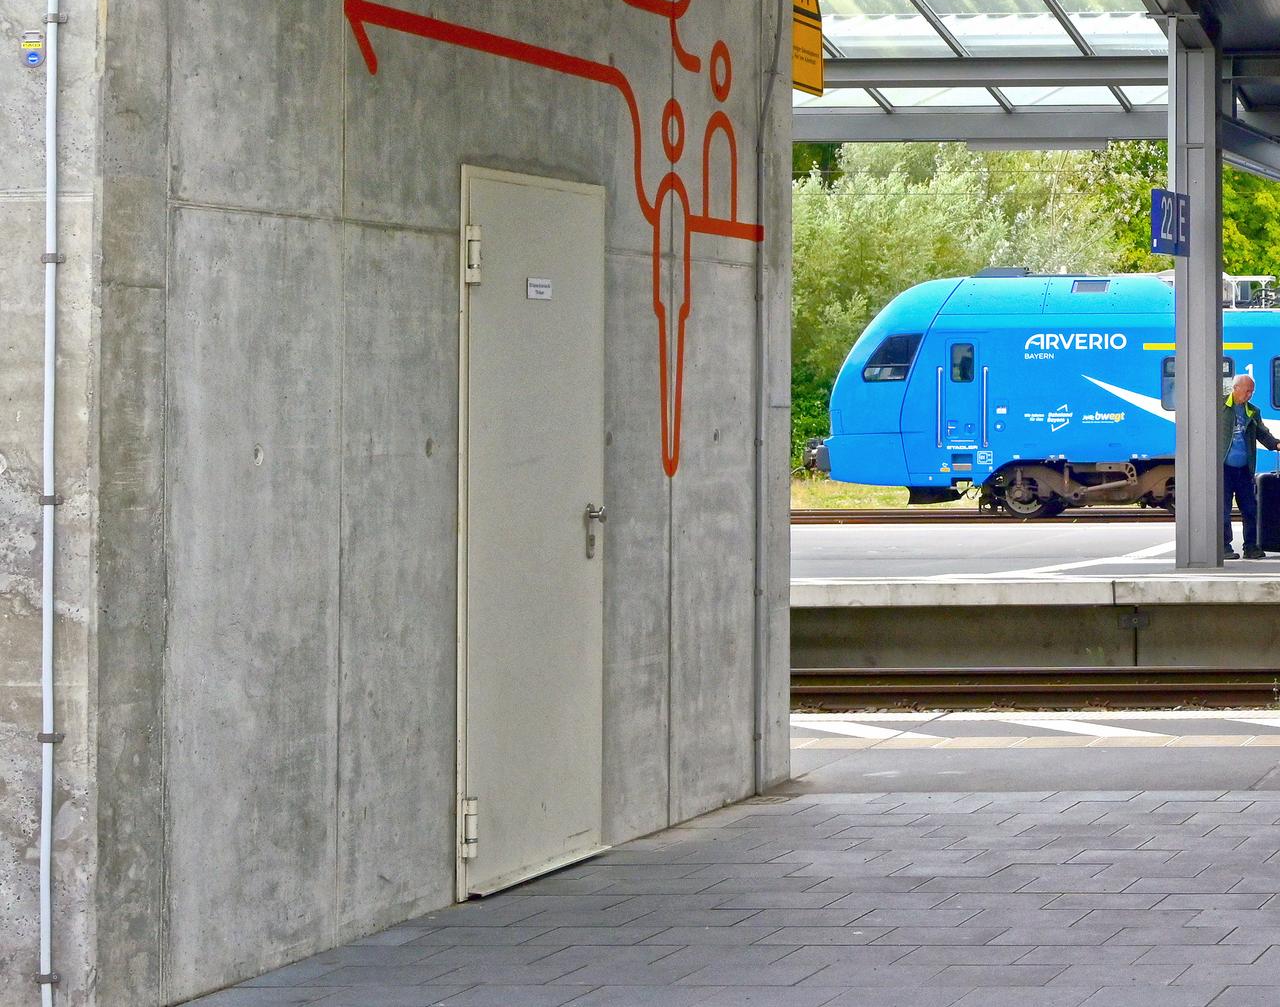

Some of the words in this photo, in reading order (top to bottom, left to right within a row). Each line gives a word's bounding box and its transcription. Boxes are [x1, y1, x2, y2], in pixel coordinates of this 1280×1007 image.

[1161, 196, 1173, 241] 22
[1180, 199, 1186, 242] E
[1025, 333, 1127, 350] ARVERIO
